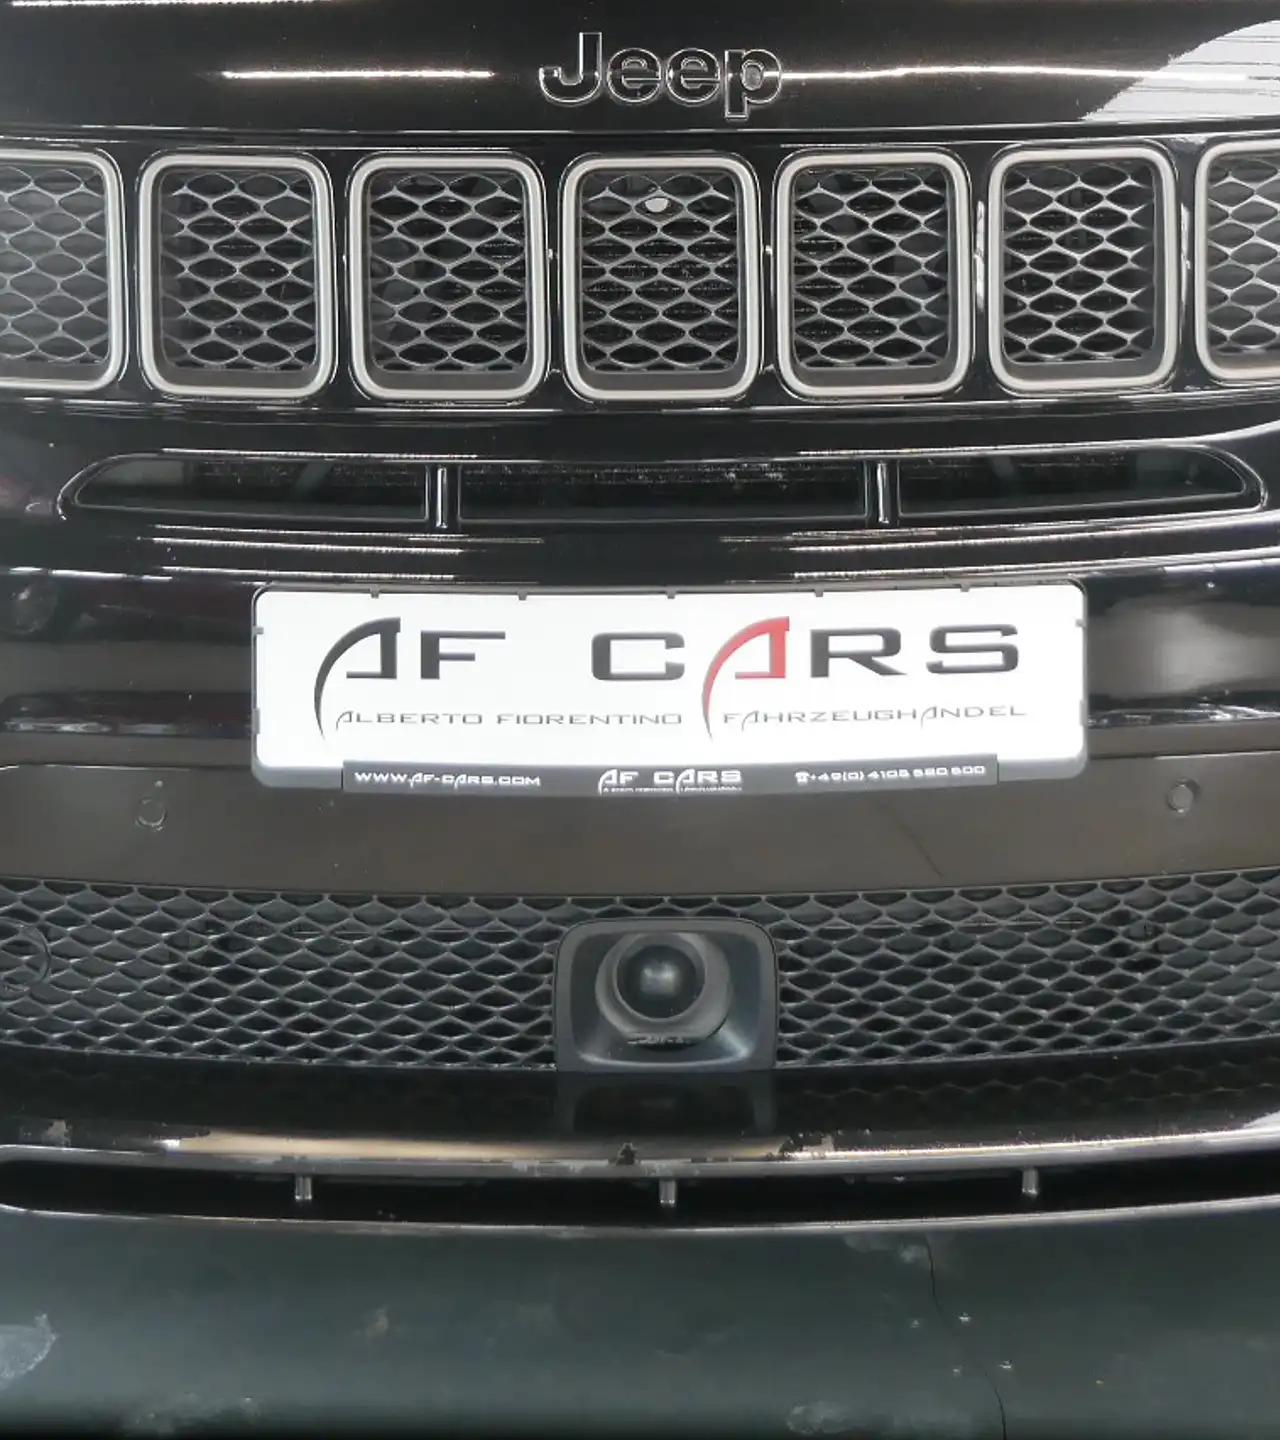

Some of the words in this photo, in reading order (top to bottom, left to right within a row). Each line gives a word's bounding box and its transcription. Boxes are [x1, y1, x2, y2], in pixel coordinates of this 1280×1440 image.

[538, 32, 783, 122] Jeep
[314, 616, 506, 741] AF
[591, 615, 1020, 741] CARS
[335, 710, 483, 731] ALBERTO
[496, 712, 683, 726] FIORENTINO
[723, 704, 1027, 733] FAHRZEUGHANDEL
[597, 768, 639, 796] AF
[652, 767, 743, 796] CARS
